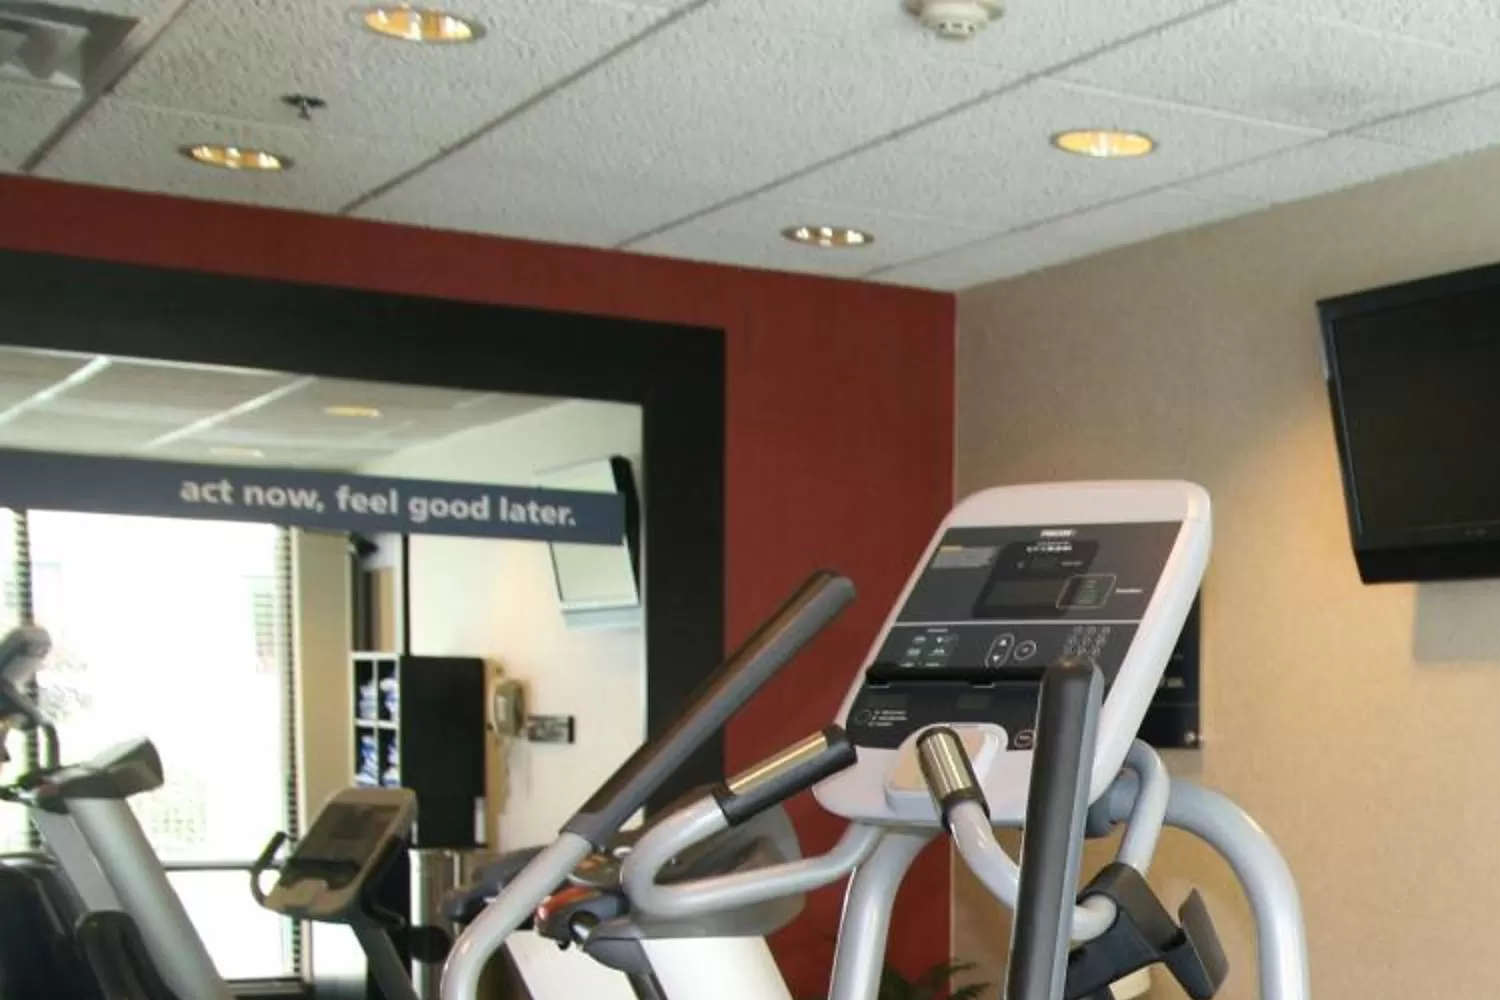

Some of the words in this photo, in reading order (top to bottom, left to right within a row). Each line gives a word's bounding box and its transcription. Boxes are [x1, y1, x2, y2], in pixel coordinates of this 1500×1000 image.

[180, 479, 233, 504] act
[242, 485, 325, 512] now,
[336, 484, 398, 516] feel
[408, 494, 490, 522] good
[500, 496, 576, 526] later.
